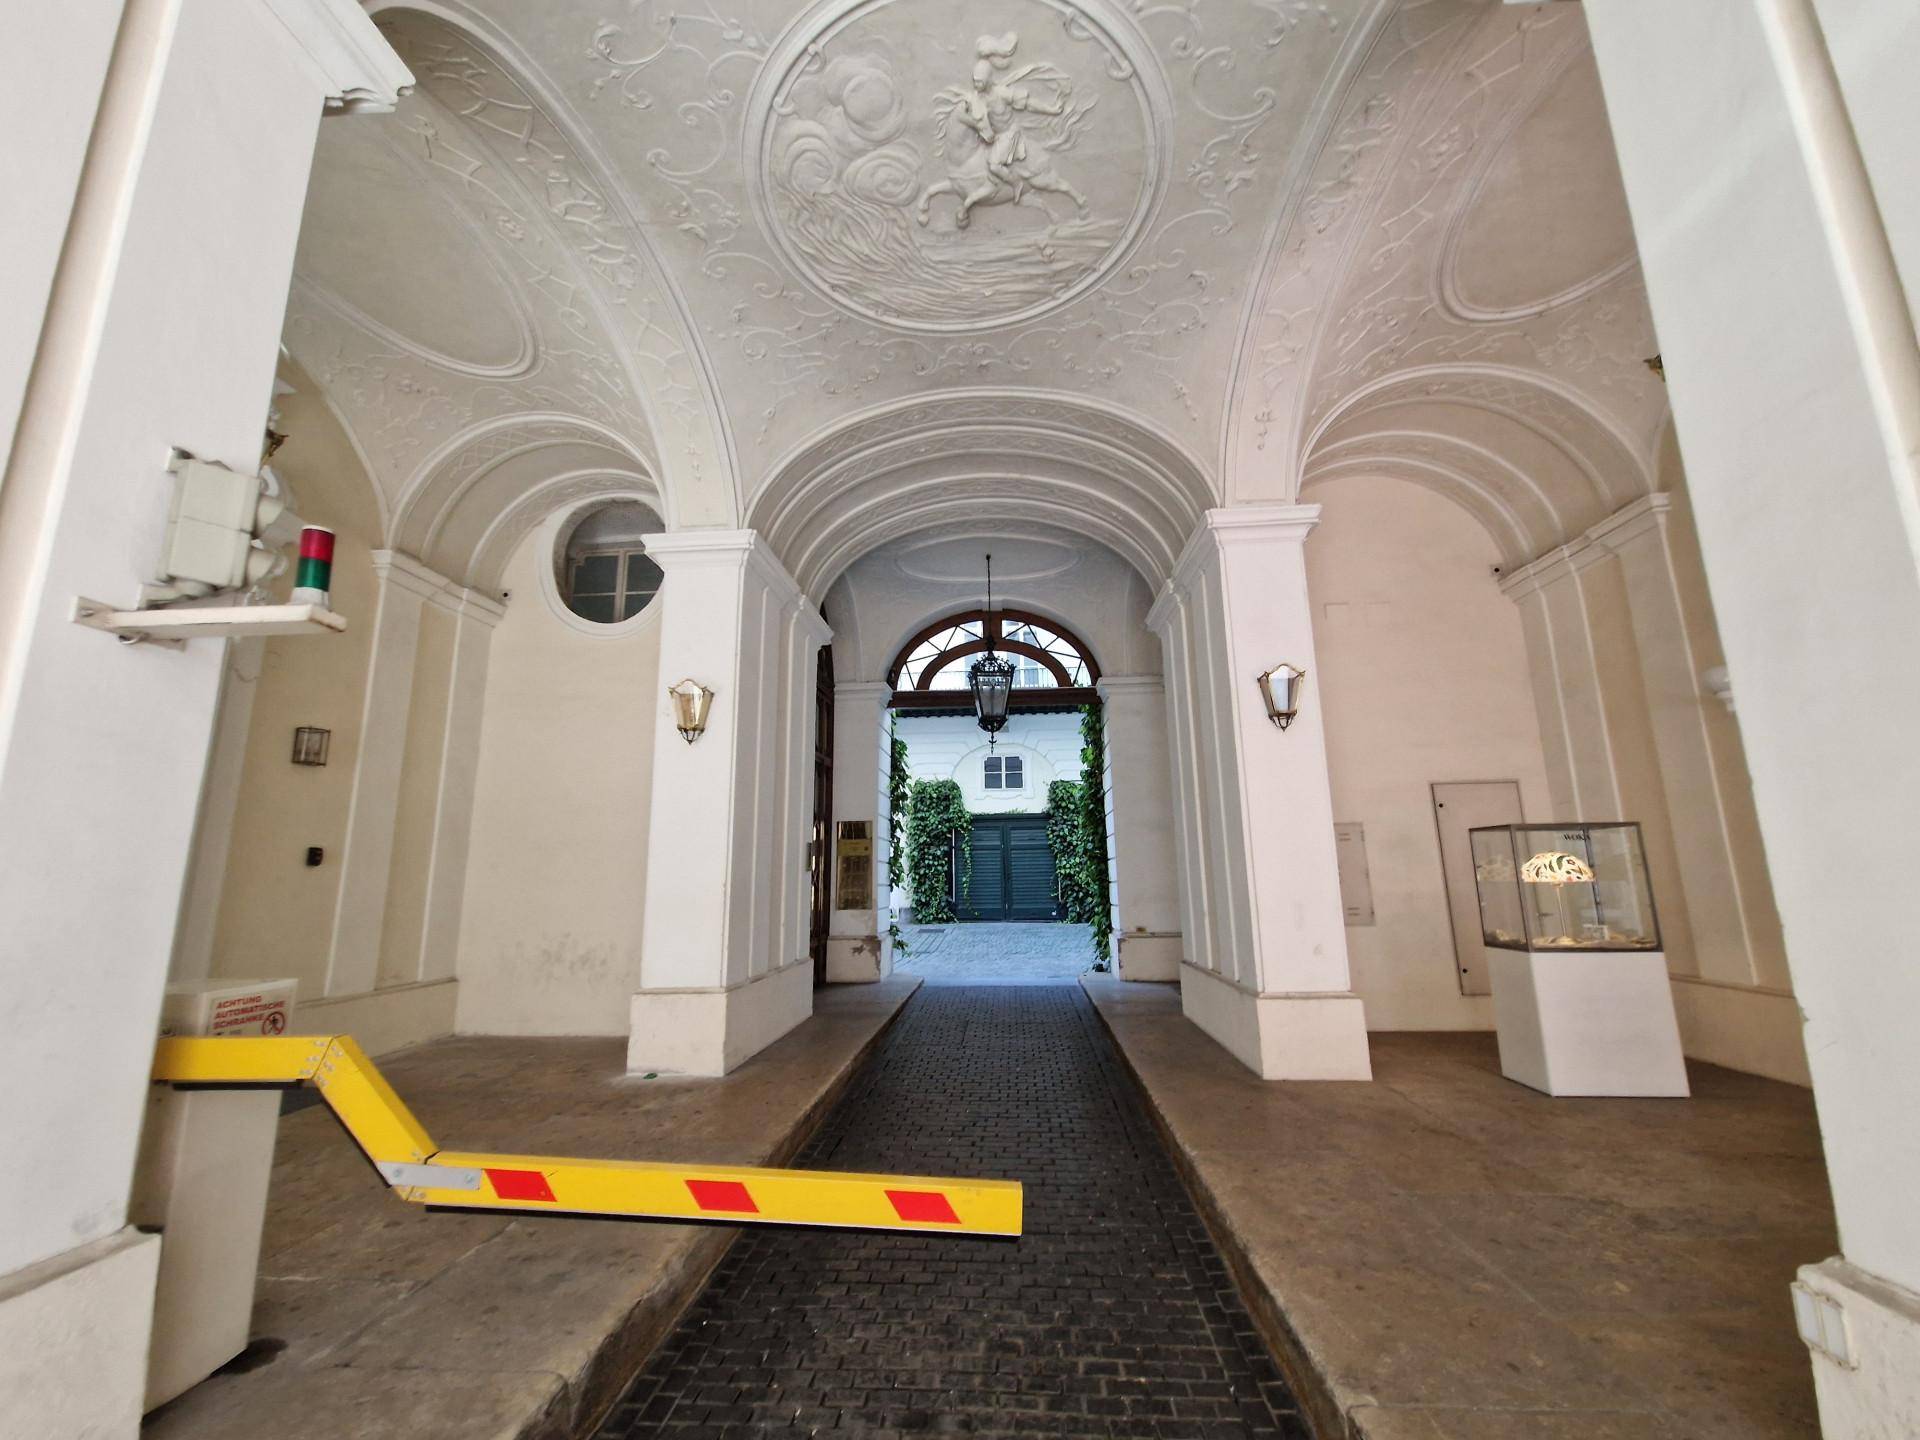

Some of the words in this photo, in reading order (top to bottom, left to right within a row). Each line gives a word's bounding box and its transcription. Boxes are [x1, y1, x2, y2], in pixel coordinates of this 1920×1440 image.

[215, 1000, 285, 1019] AUTOMATISCHE
[216, 995, 261, 1008] ACHTUNG
[213, 1013, 263, 1029] SCHRANKE
